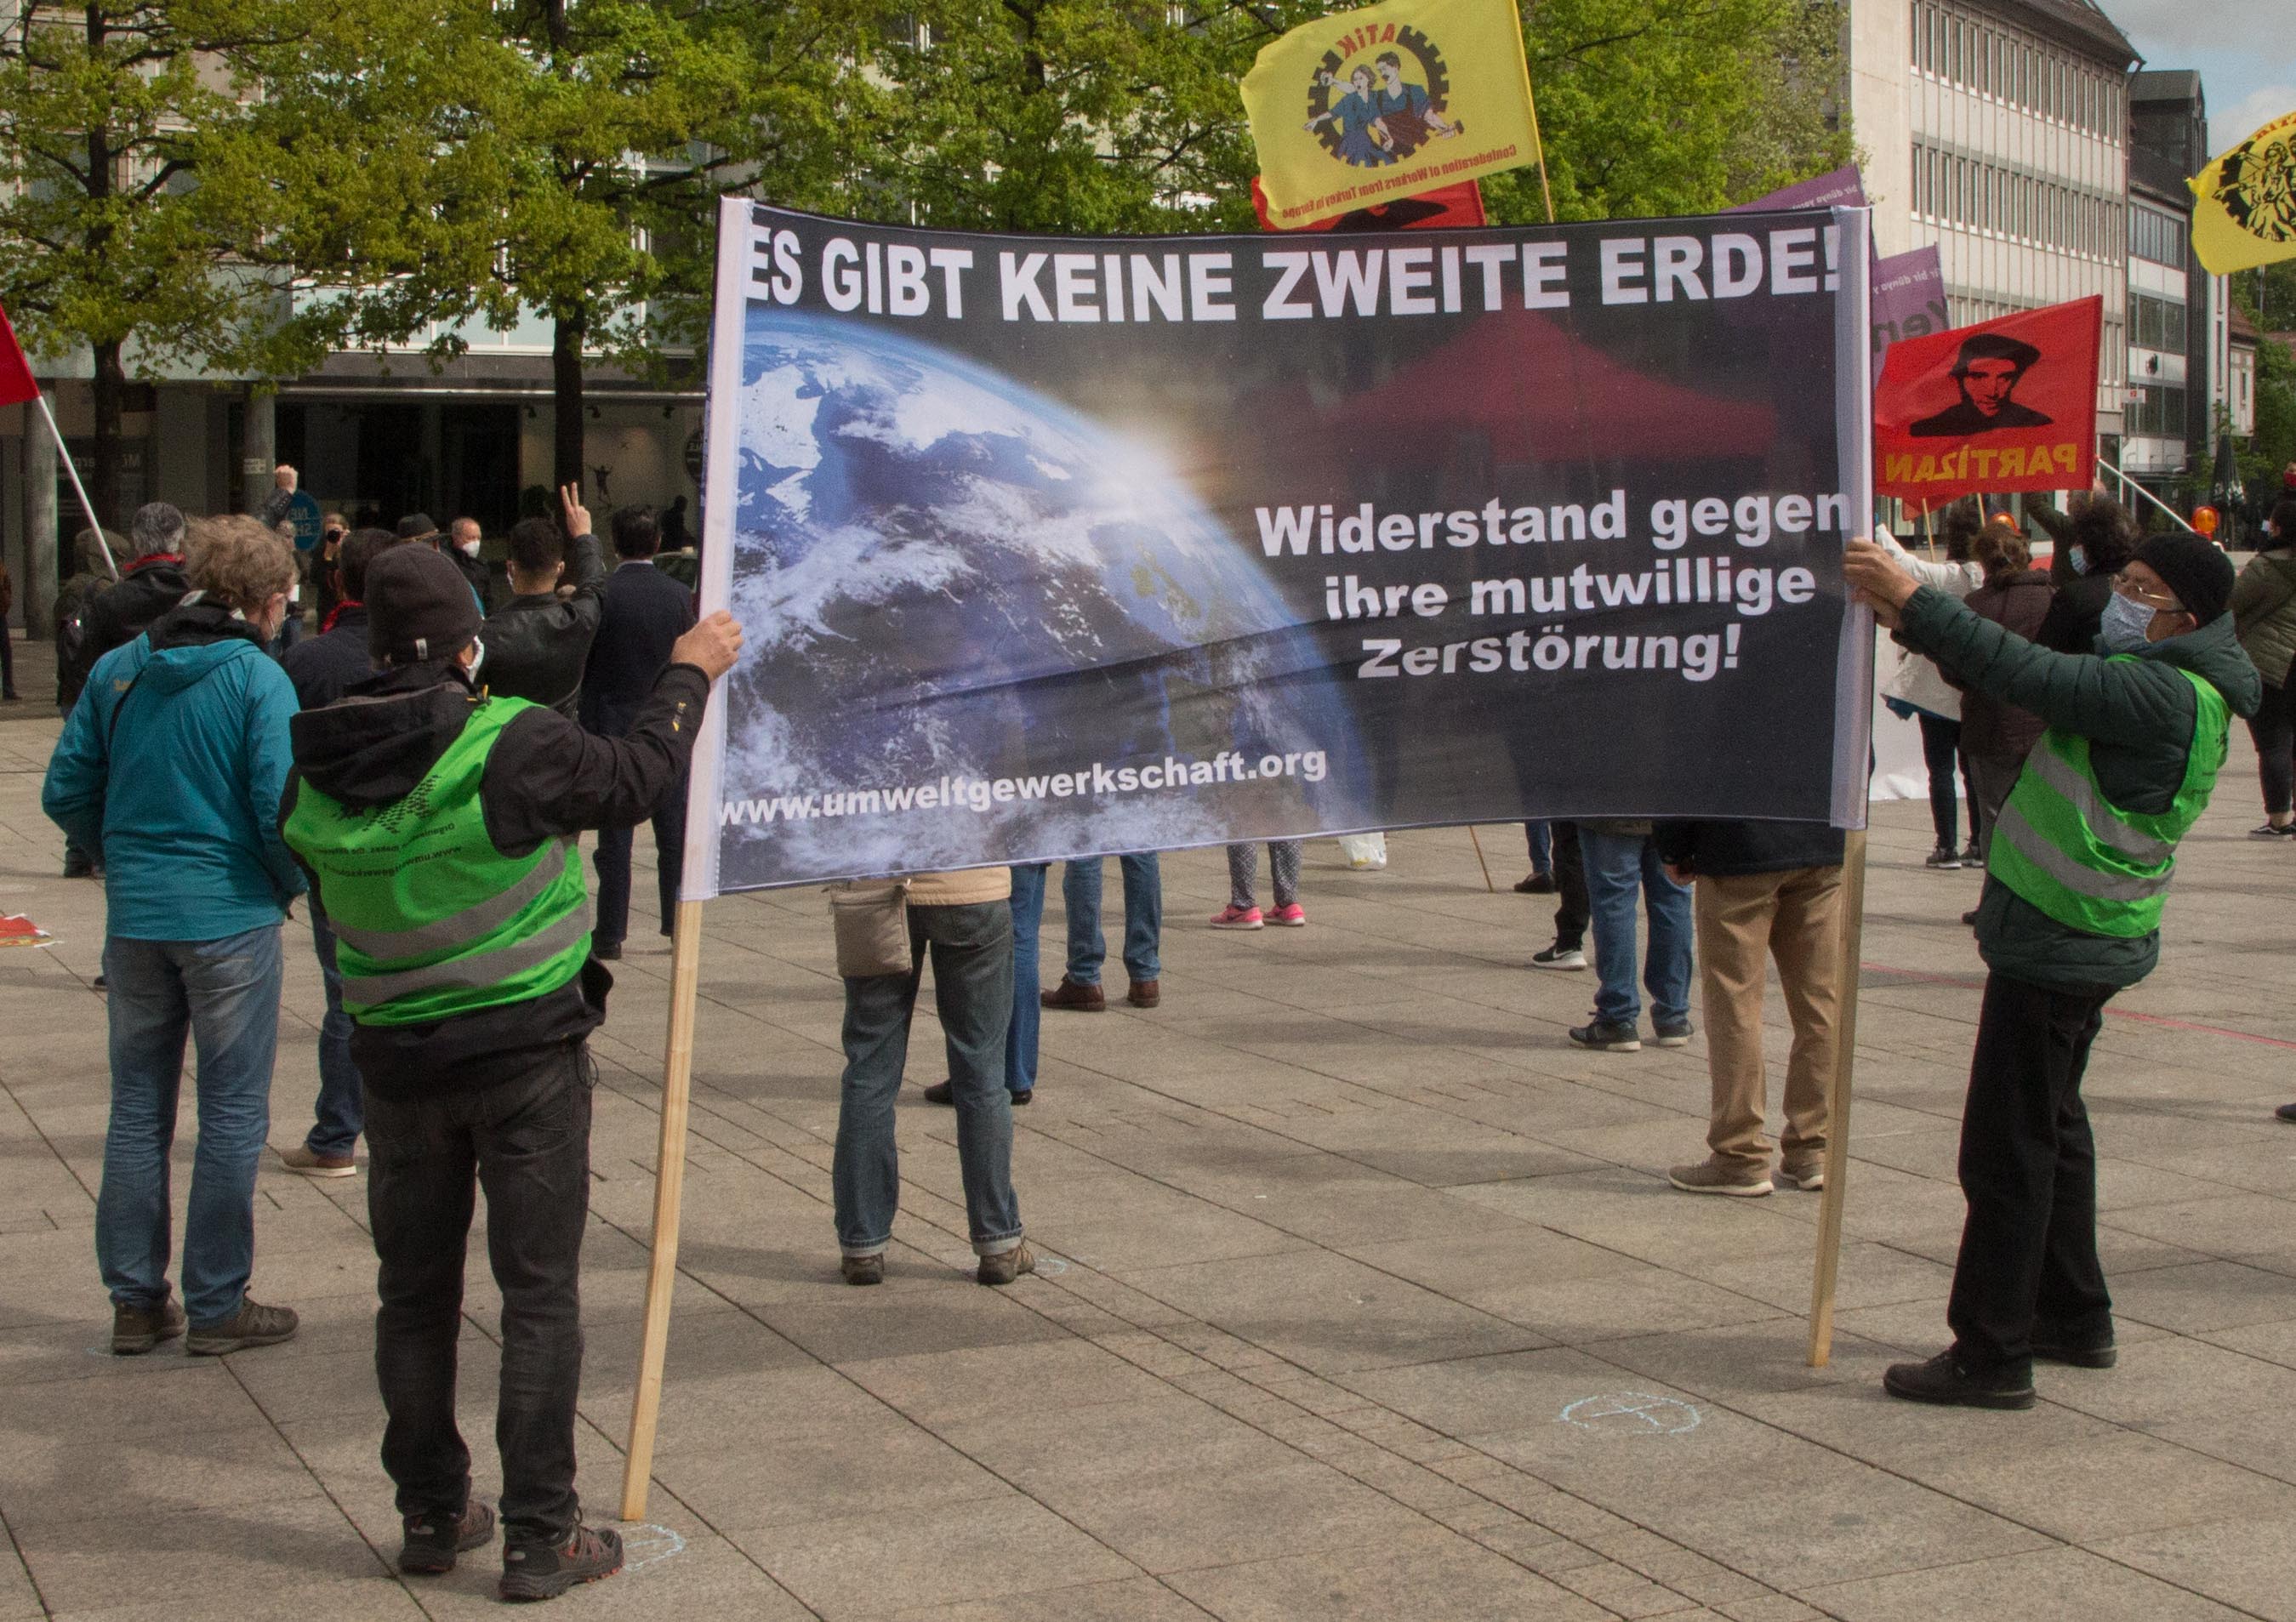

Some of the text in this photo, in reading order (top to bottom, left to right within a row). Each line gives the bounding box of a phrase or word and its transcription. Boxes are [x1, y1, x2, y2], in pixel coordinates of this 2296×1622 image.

[746, 225, 1840, 322] ES GIBT KEINE ZWEITE ERDE!
[1254, 489, 1851, 557] Widerstand gegen
[1325, 556, 1816, 621] ihre mutwillige
[1357, 623, 1742, 683] Zerstörung!
[721, 750, 1327, 825] www.umweltgewerkschaft.org
